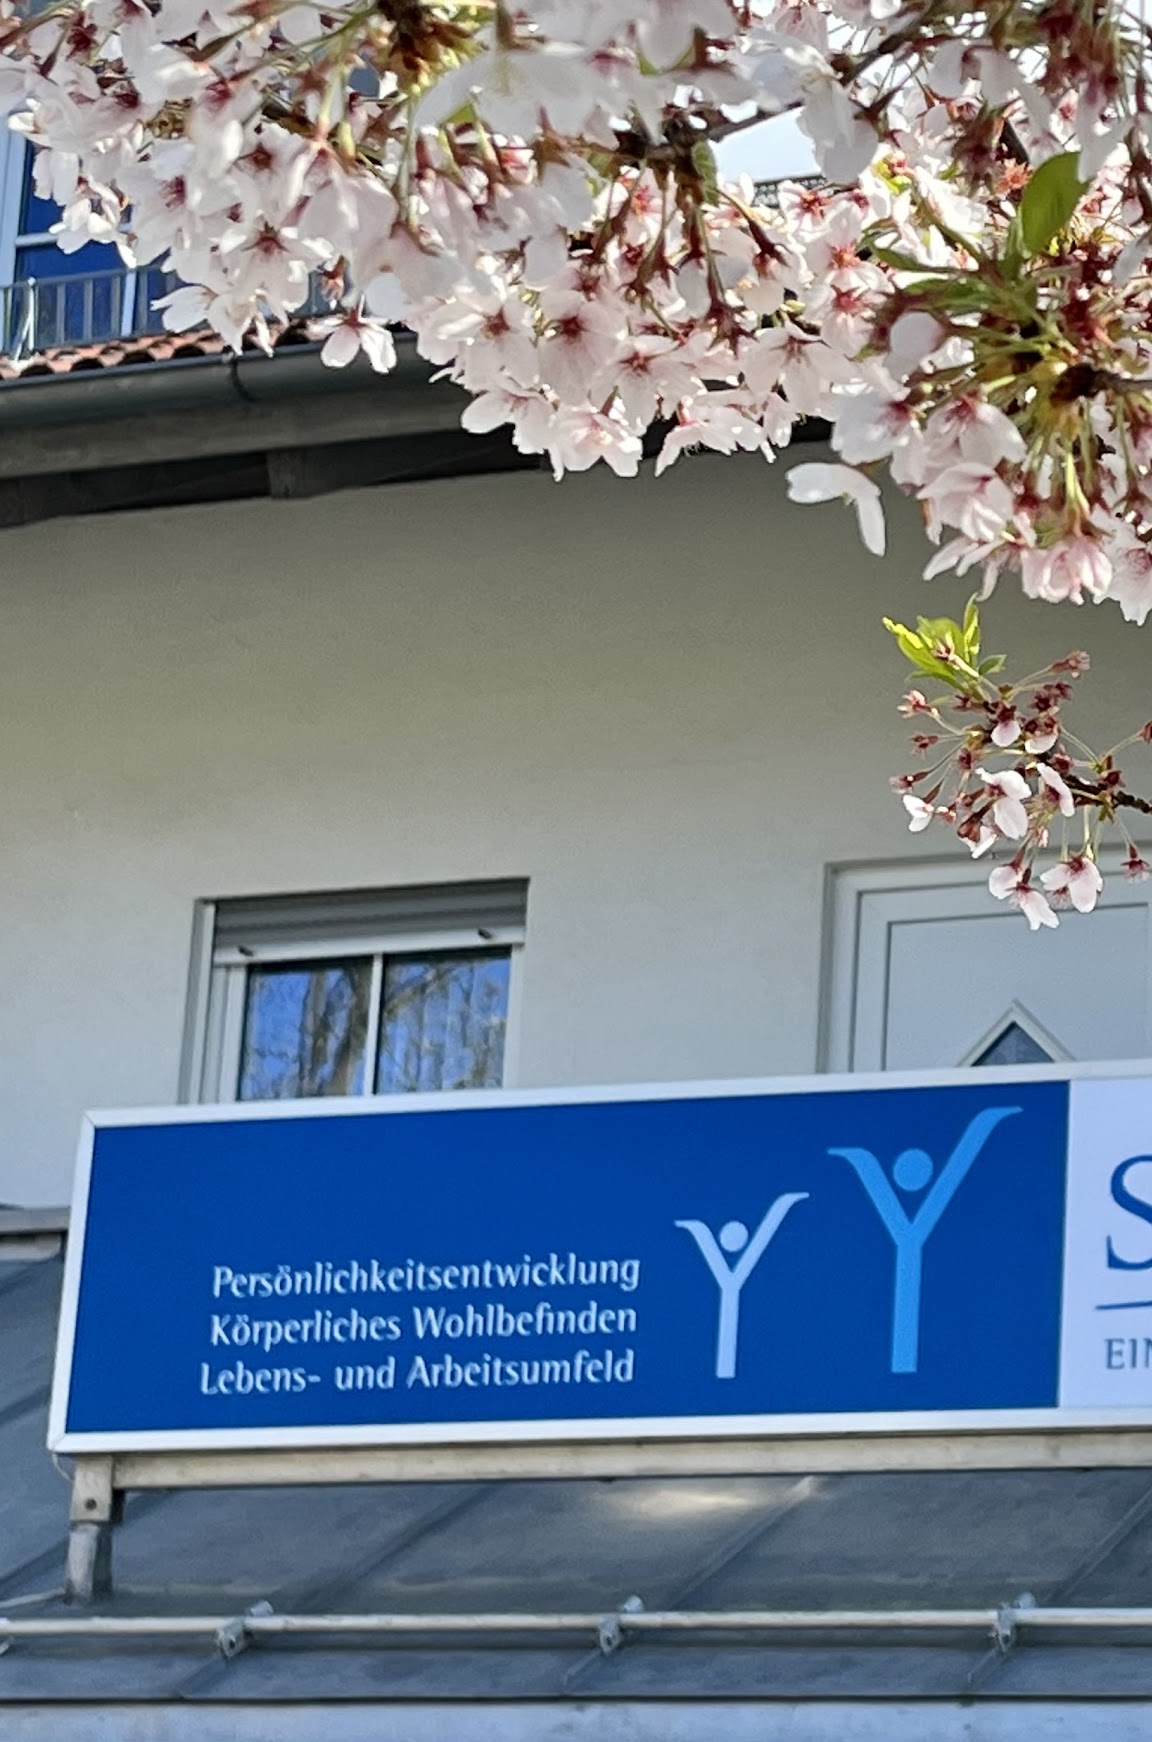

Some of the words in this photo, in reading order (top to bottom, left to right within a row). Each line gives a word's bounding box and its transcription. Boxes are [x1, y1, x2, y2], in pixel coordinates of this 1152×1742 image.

[213, 1252, 641, 1298] Persönlichkeitsentwicklung
[210, 1308, 402, 1353] Körperliches
[412, 1300, 637, 1340] Wohlbefinden
[200, 1360, 321, 1395] Lebens-
[335, 1355, 396, 1391] und
[406, 1348, 635, 1388] Arbeitsumfeld
